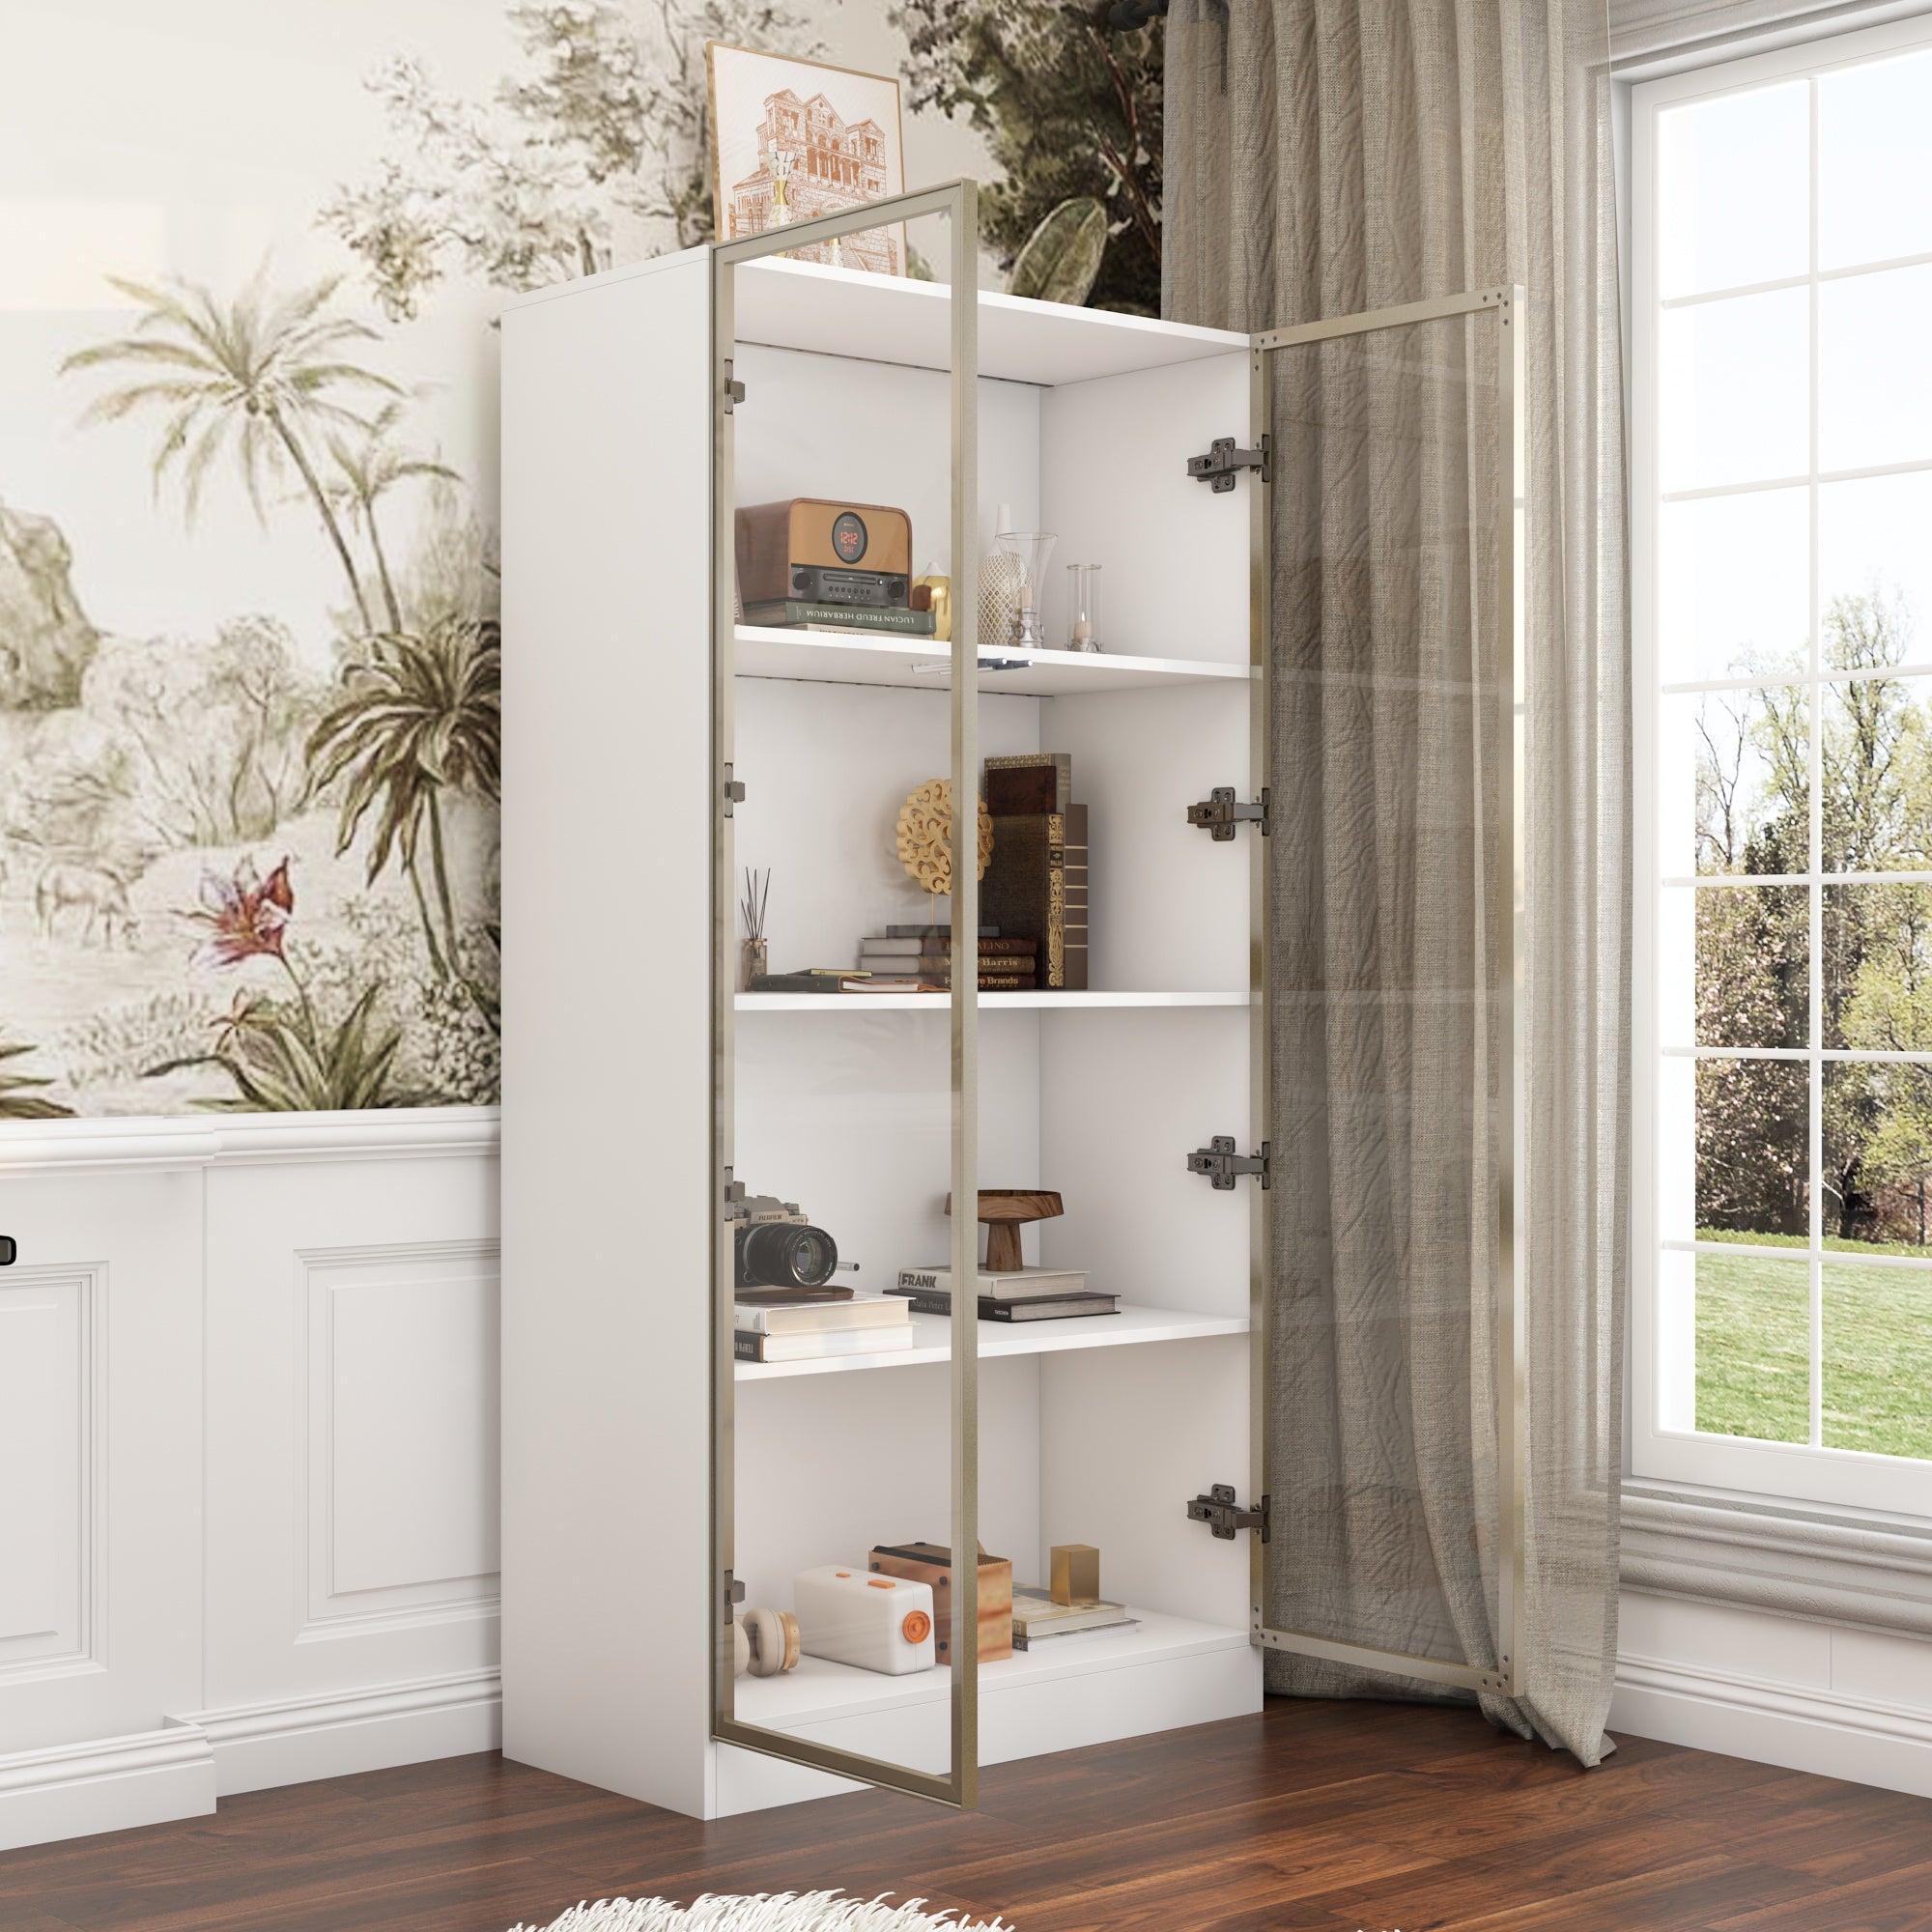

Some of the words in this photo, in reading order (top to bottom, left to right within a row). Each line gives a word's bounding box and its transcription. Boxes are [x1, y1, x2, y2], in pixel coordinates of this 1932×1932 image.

[806, 610, 854, 619] HERBARIUM
[857, 613, 882, 622] FREUD
[982, 957, 1018, 966] Harris
[902, 1273, 936, 1288] FRANK
